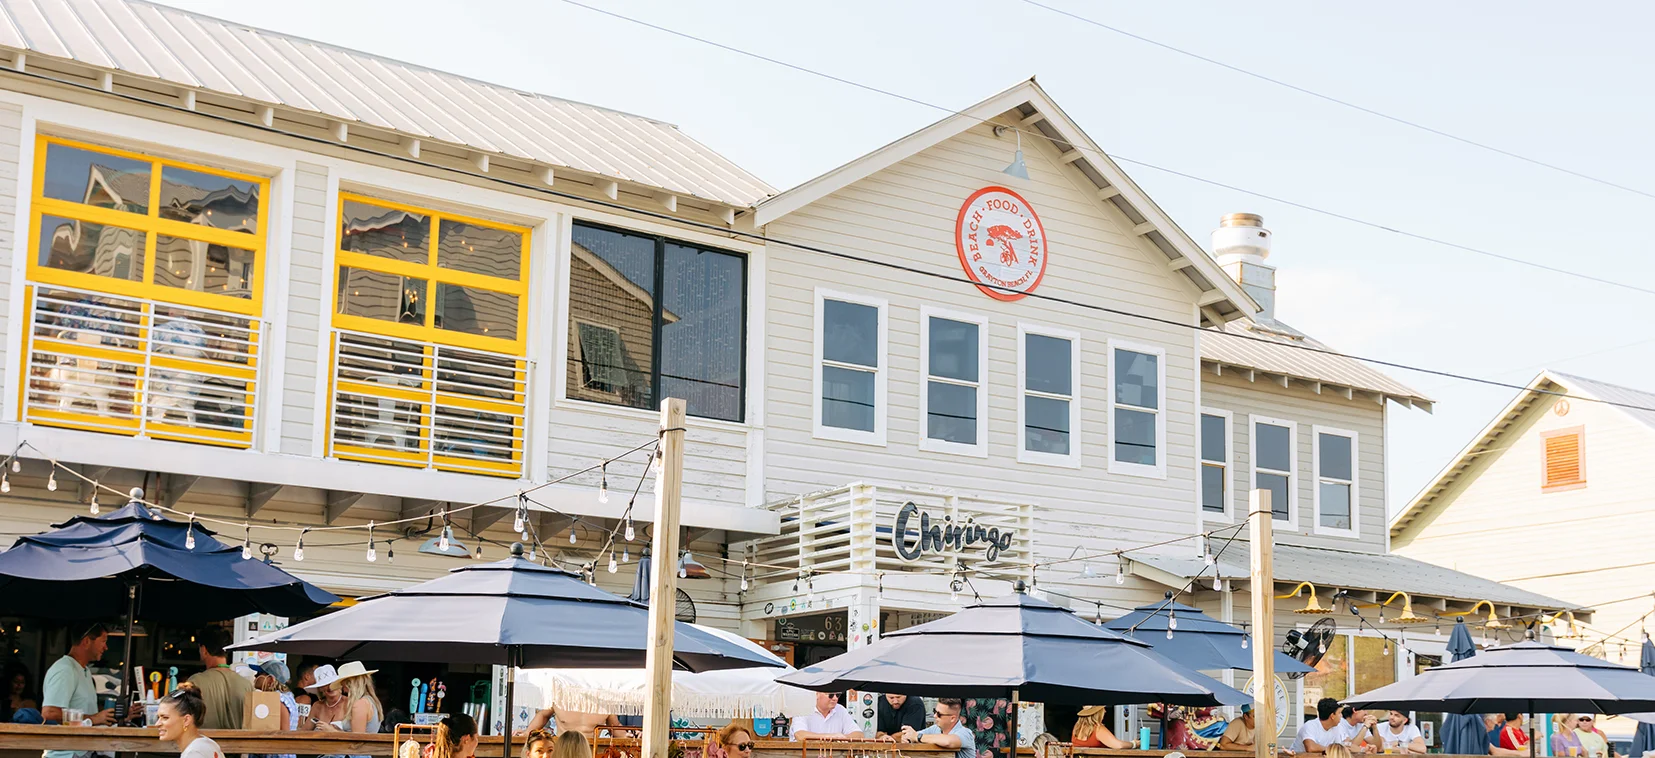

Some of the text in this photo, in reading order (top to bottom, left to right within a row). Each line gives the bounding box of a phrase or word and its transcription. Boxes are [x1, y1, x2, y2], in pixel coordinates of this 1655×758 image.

[969, 199, 1038, 267] BEACH FOOD DRINK
[979, 266, 1007, 287] GRAYTON
[893, 500, 1015, 562] Chiringo
[824, 616, 843, 631] 63
